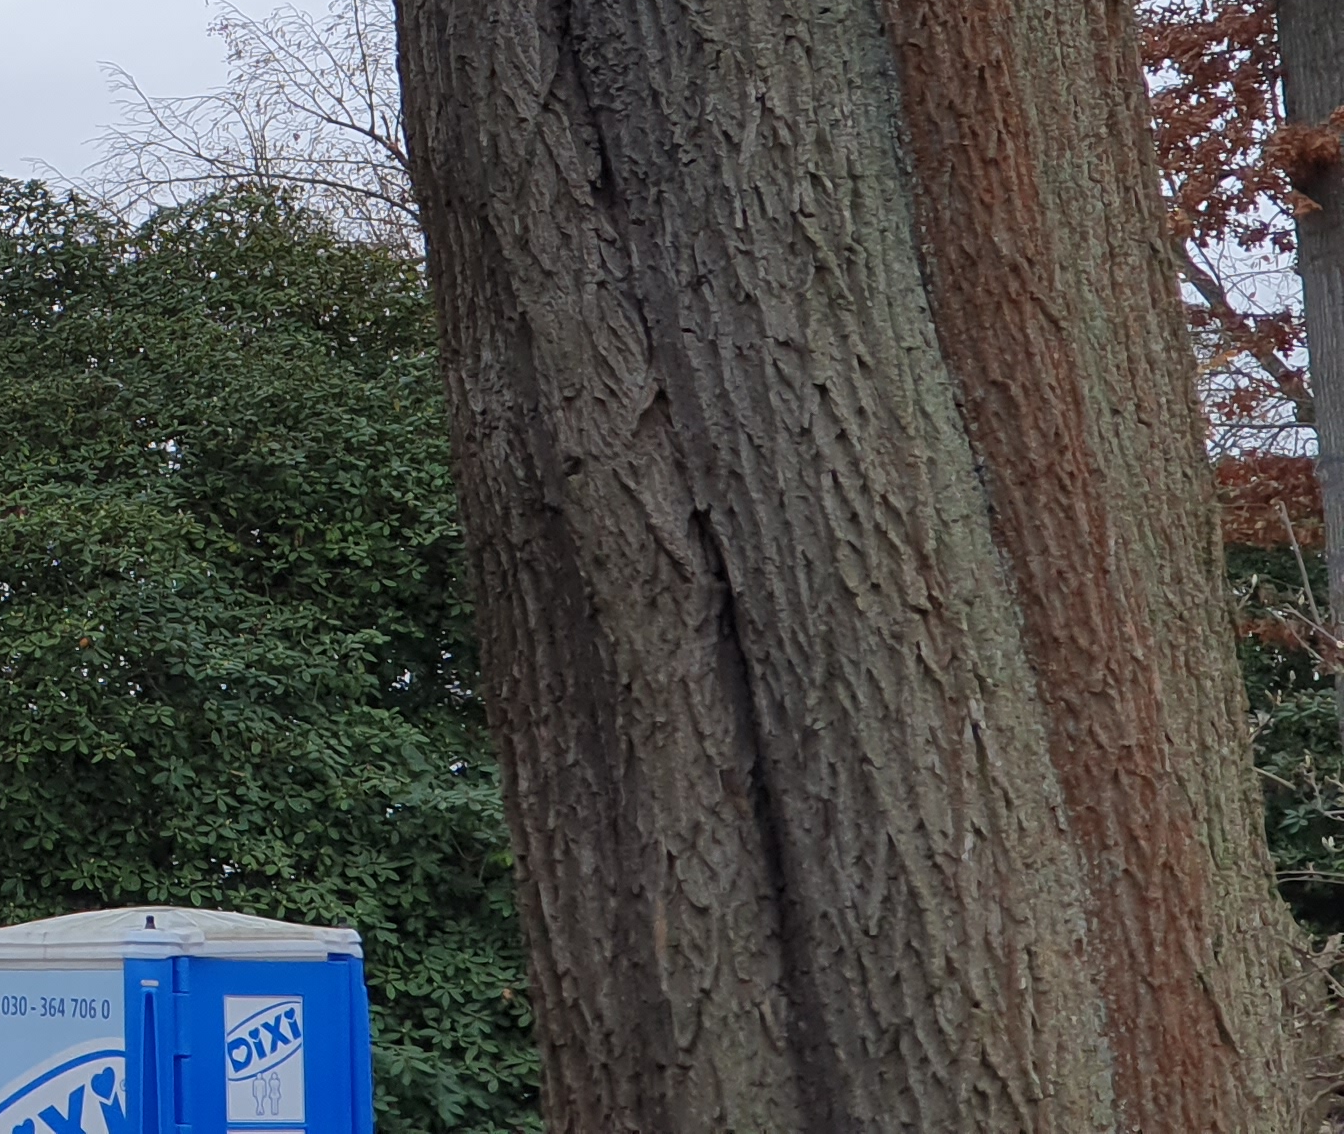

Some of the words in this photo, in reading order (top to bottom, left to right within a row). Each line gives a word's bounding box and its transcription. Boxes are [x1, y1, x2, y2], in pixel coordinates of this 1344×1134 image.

[1, 995, 28, 1016] 030
[40, 997, 65, 1017] 364
[70, 998, 97, 1019] 706
[101, 999, 111, 1020] 0
